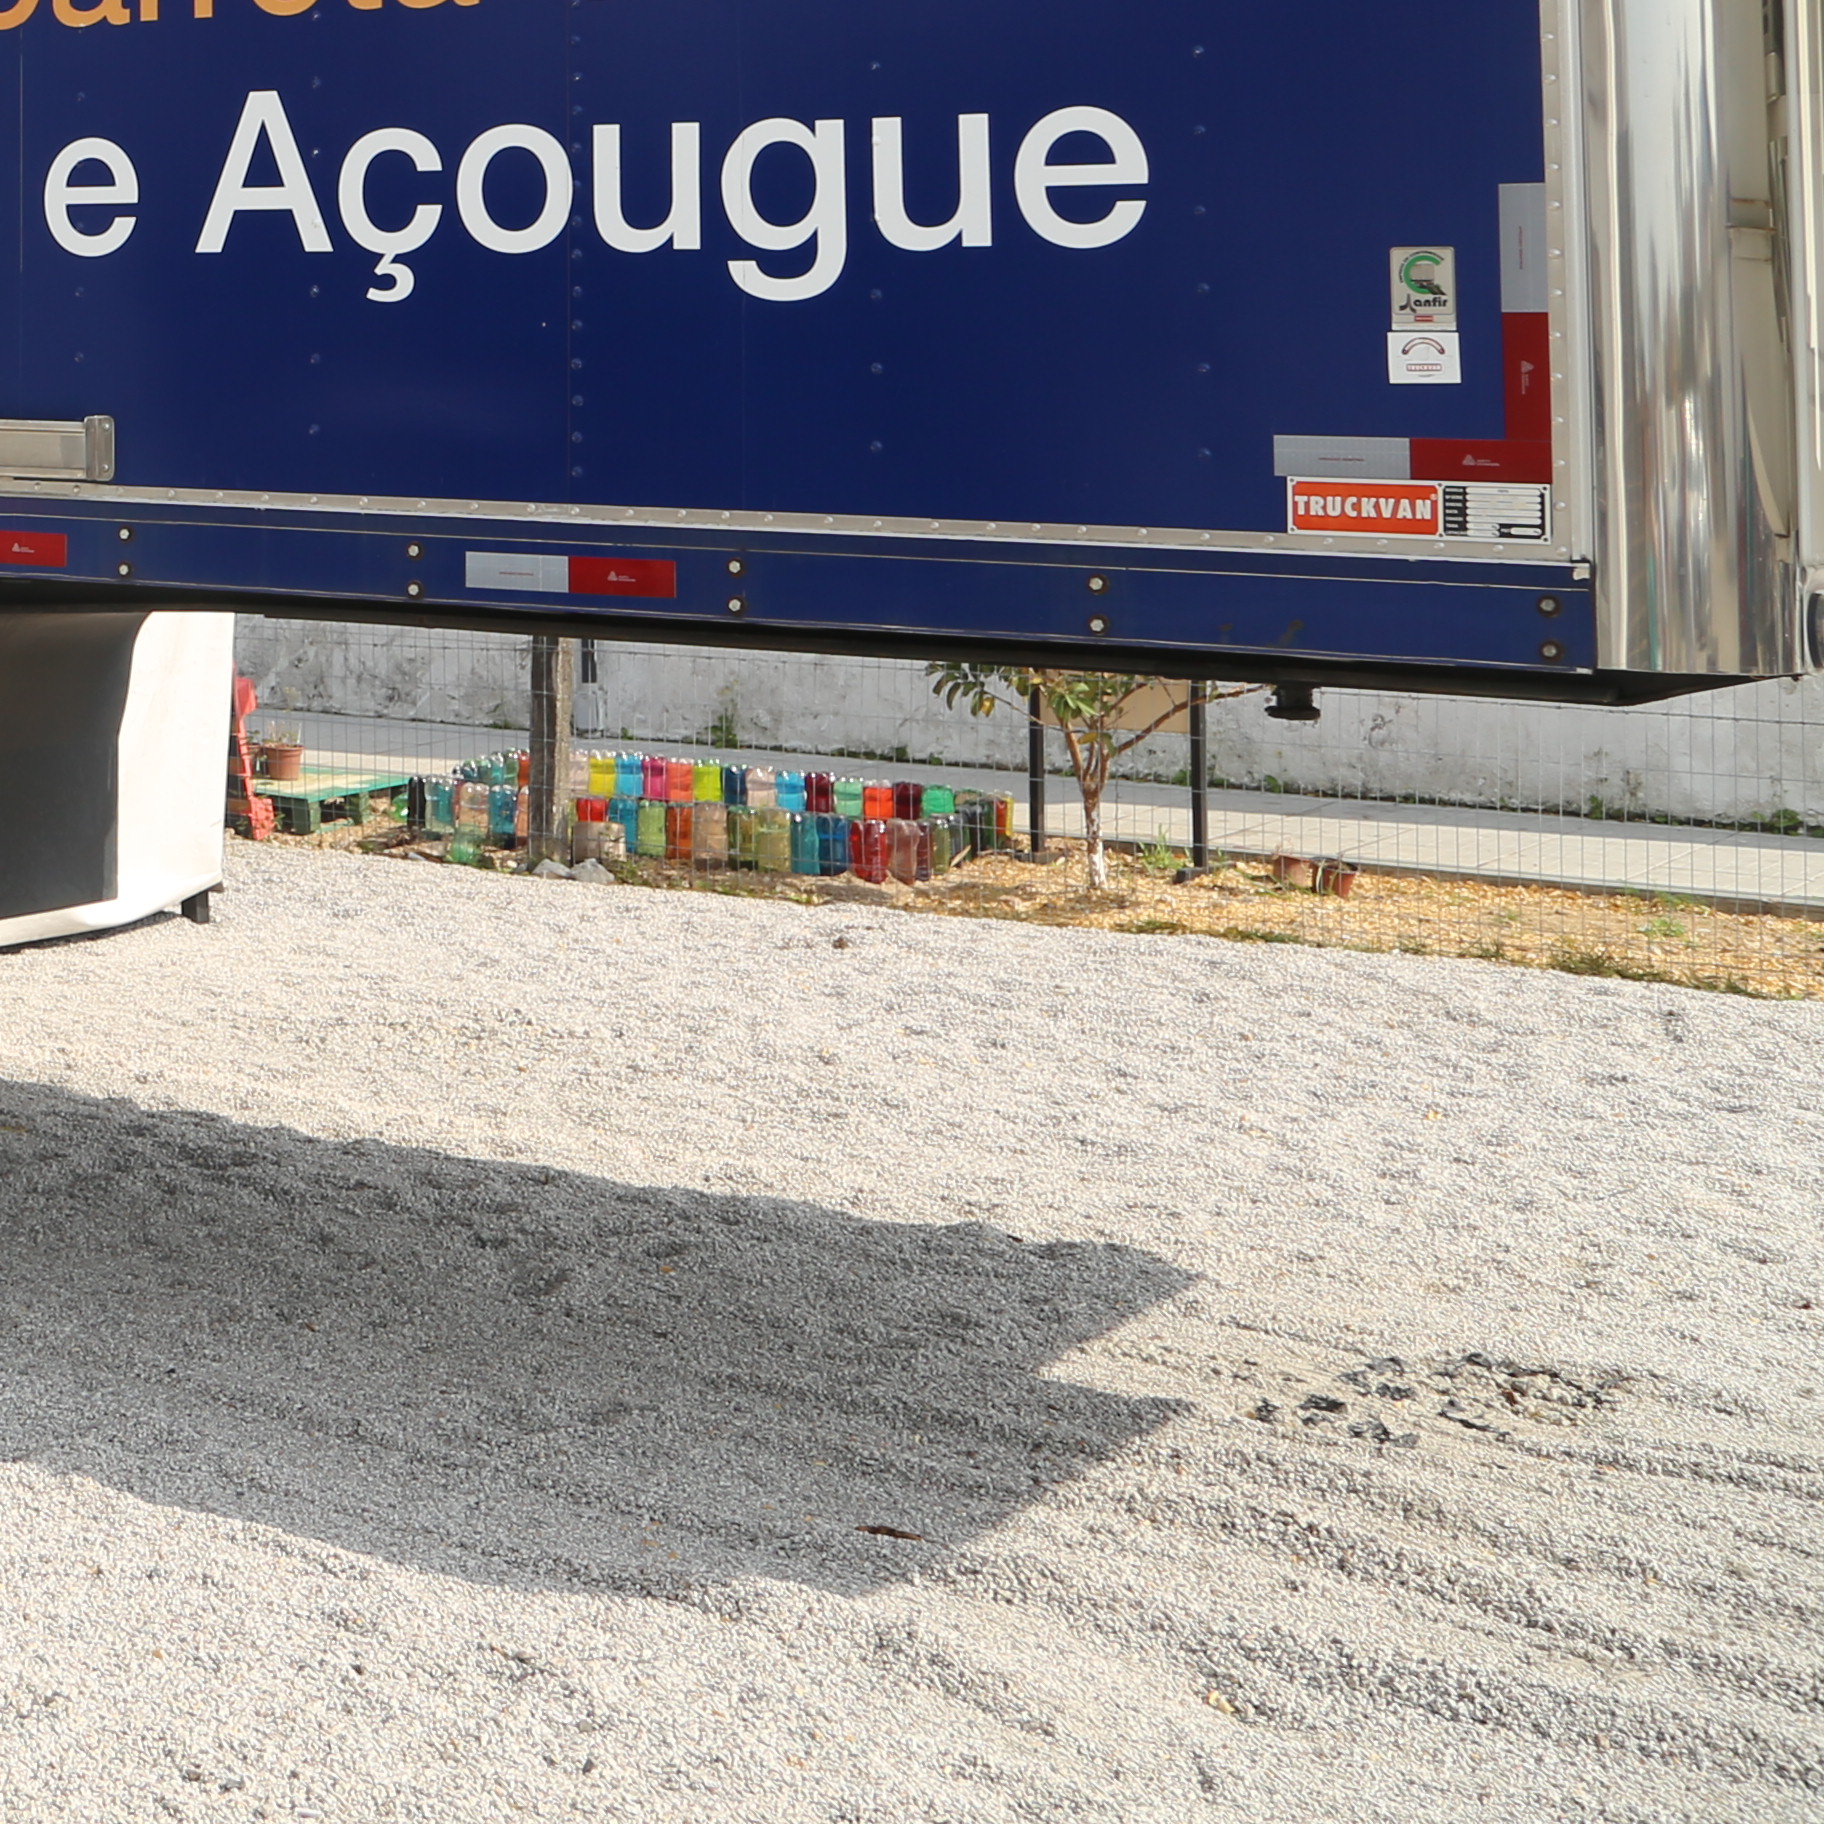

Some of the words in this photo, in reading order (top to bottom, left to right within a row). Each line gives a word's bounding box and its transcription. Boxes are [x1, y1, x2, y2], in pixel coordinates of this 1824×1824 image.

[44, 135, 140, 258] e
[195, 91, 1150, 302] Açougue
[1294, 495, 1432, 520] TRUCKVAN
